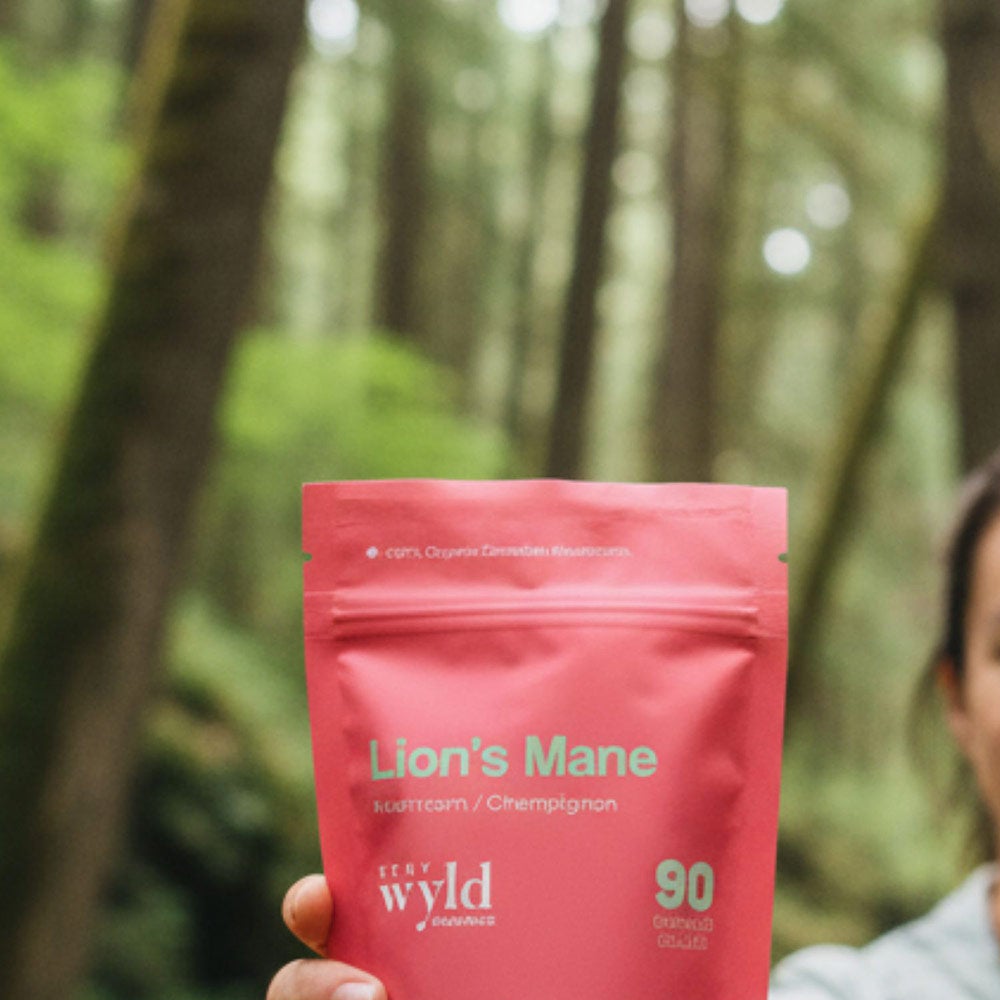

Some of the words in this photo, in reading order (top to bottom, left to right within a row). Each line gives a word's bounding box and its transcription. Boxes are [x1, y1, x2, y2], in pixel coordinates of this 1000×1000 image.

[370, 737, 508, 780] Lion's
[525, 735, 658, 777] Mane
[380, 861, 493, 932] wyld
[655, 859, 714, 912] 90
